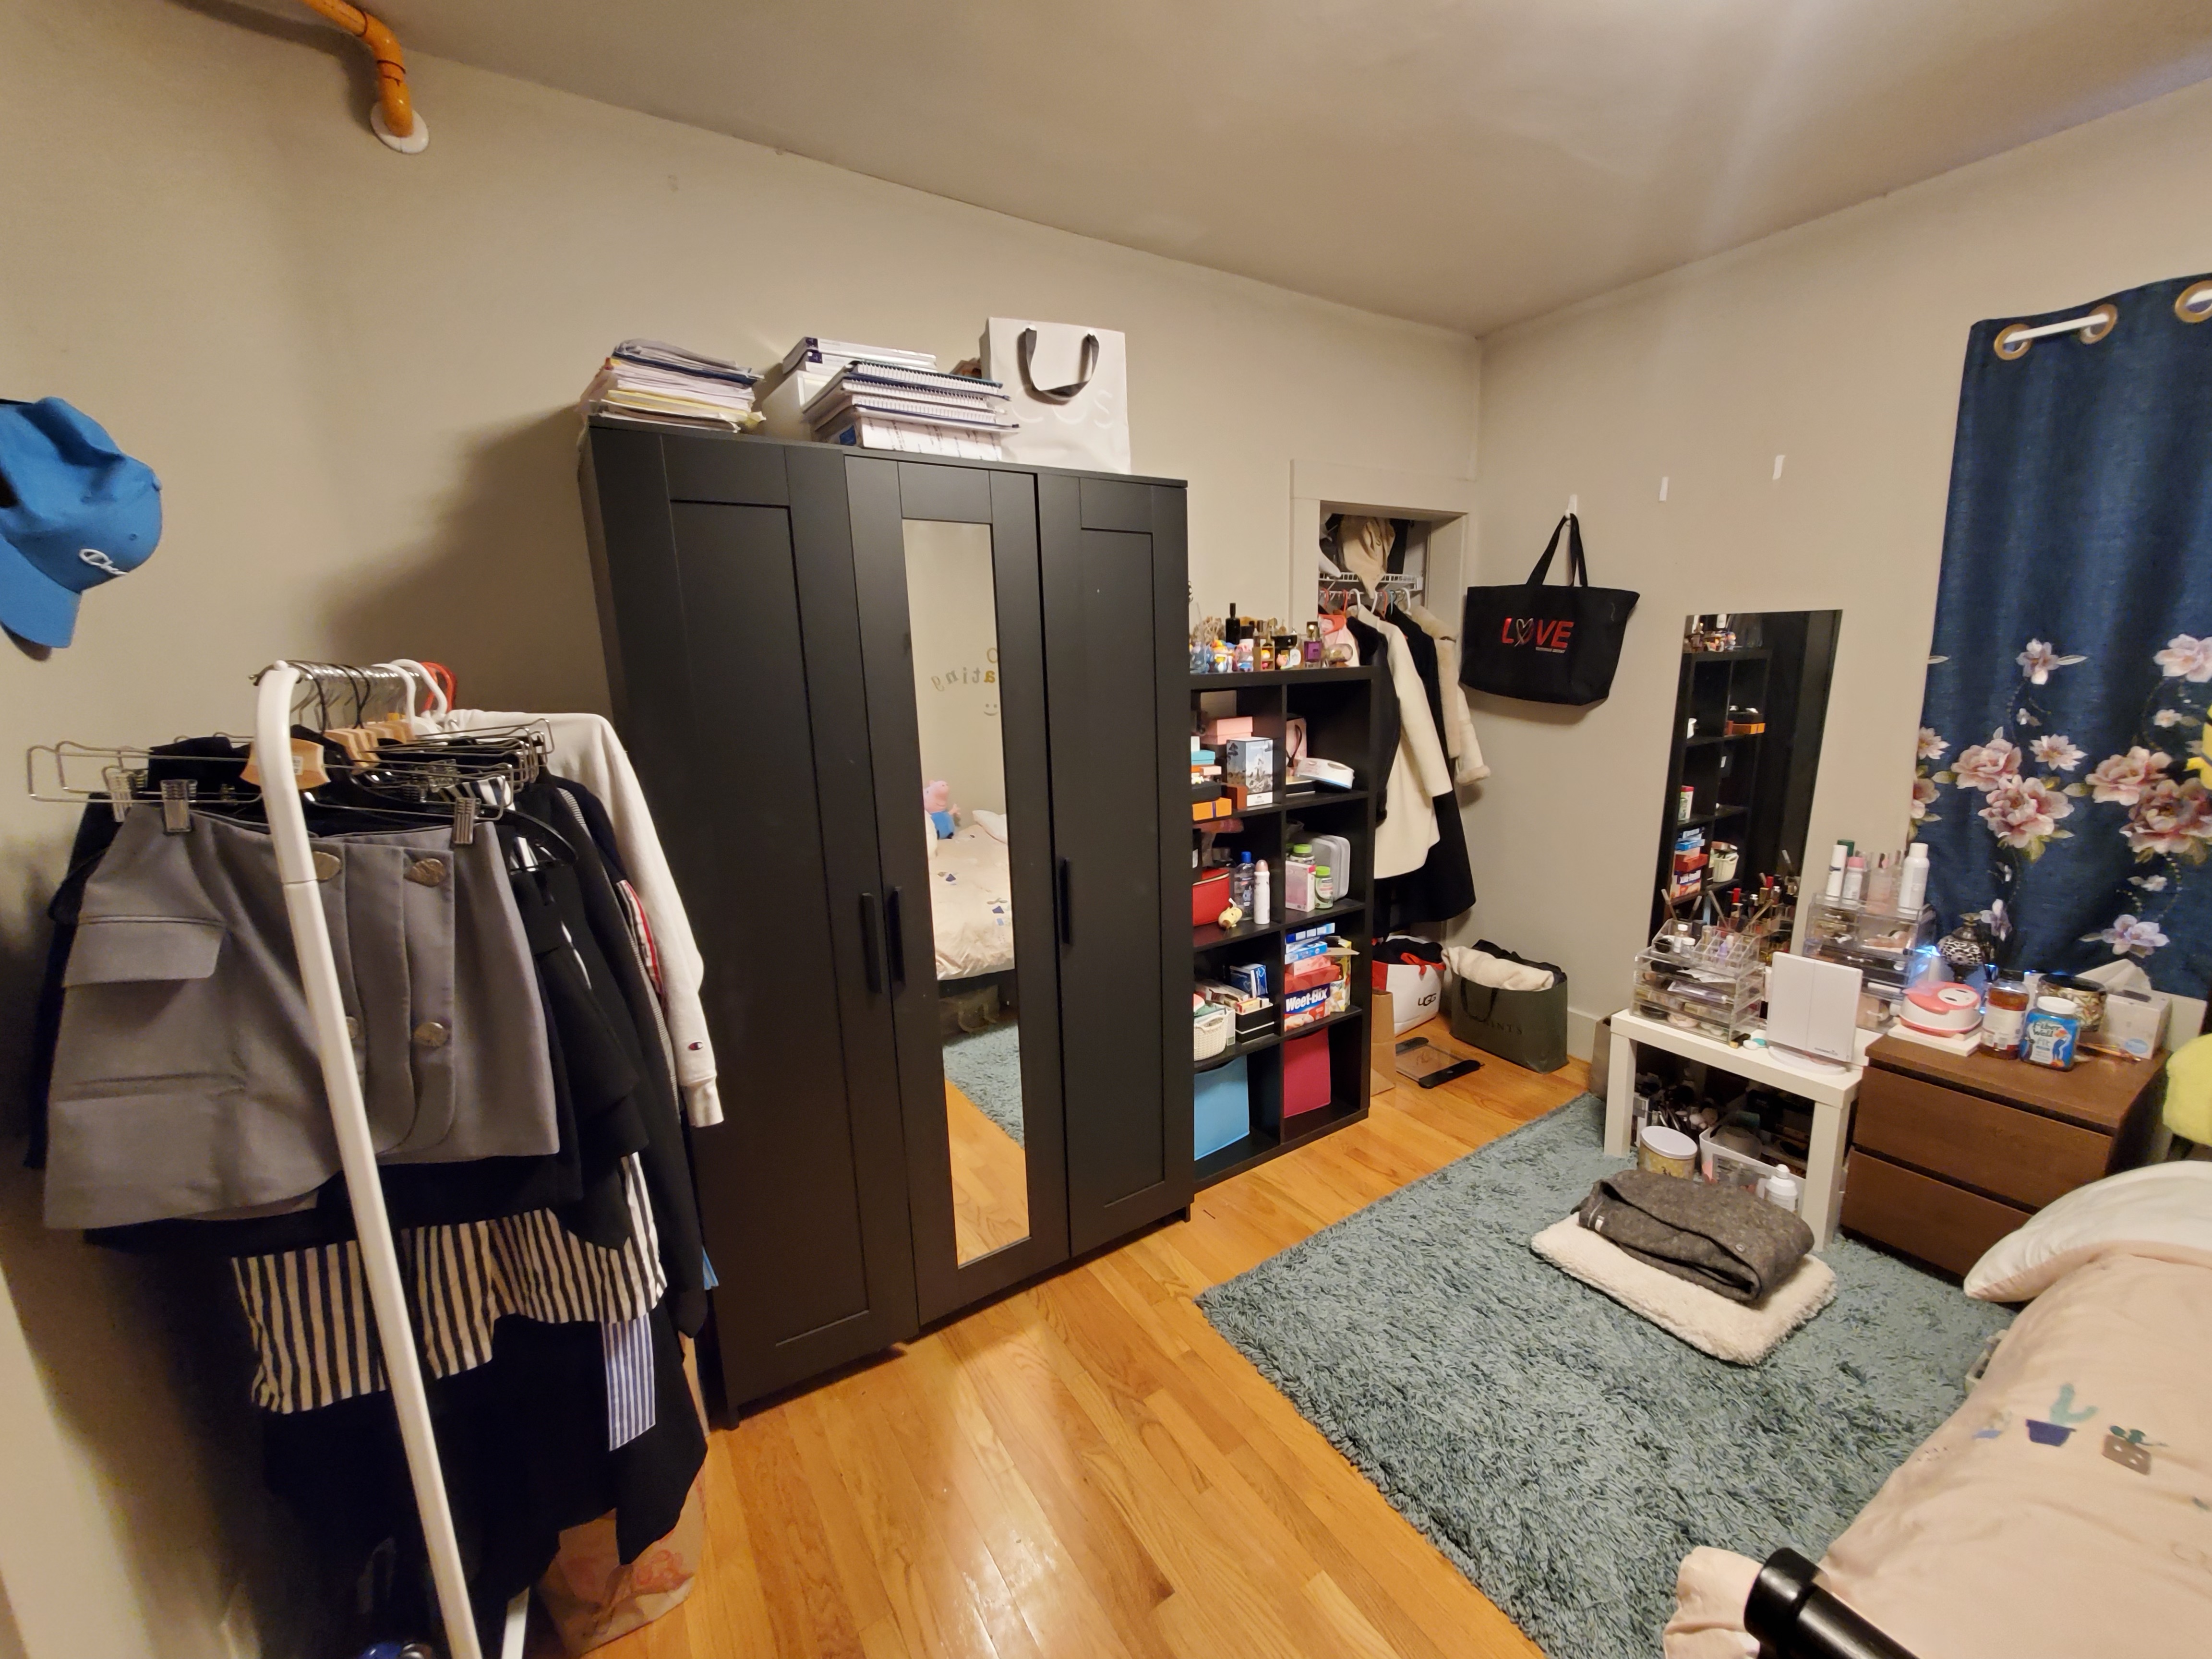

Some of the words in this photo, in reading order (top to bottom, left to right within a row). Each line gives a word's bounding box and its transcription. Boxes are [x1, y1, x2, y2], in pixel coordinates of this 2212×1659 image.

[1502, 617, 1575, 648] LOVE
[1286, 987, 1328, 1012] Weet-Bix
[1418, 993, 1437, 1006] UGG
